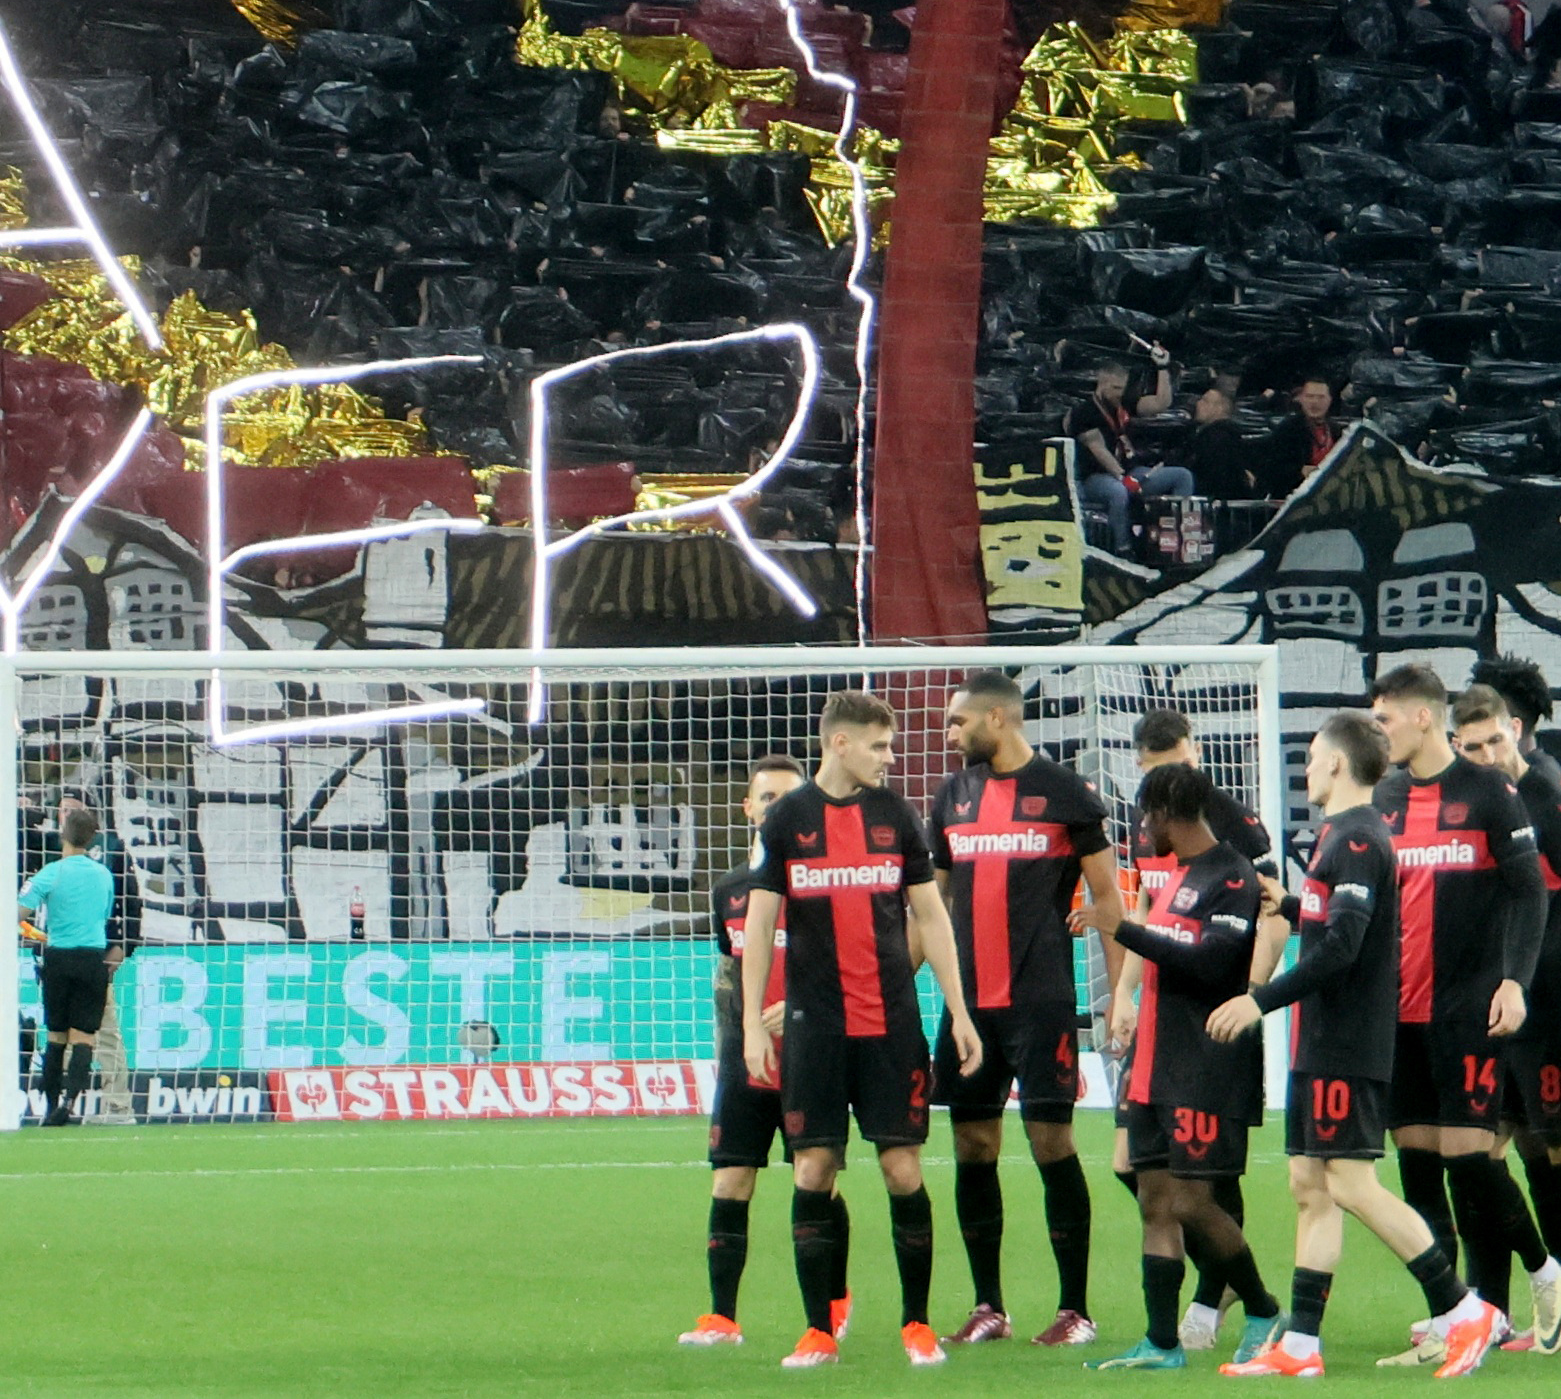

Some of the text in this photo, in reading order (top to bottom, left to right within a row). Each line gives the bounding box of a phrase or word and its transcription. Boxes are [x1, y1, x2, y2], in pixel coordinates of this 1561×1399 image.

[947, 828, 1048, 855] Barmenia
[1396, 838, 1475, 867] rmenia
[789, 860, 902, 890] Barmenia
[134, 949, 611, 1070] BESTE
[1055, 1032, 1073, 1069] 4
[343, 1066, 633, 1118] STRAUSS
[1462, 1054, 1498, 1095] 14
[1539, 1064, 1561, 1102] 8
[148, 1074, 261, 1116] bwin
[1311, 1079, 1351, 1120] 10
[1172, 1107, 1220, 1144] 30
